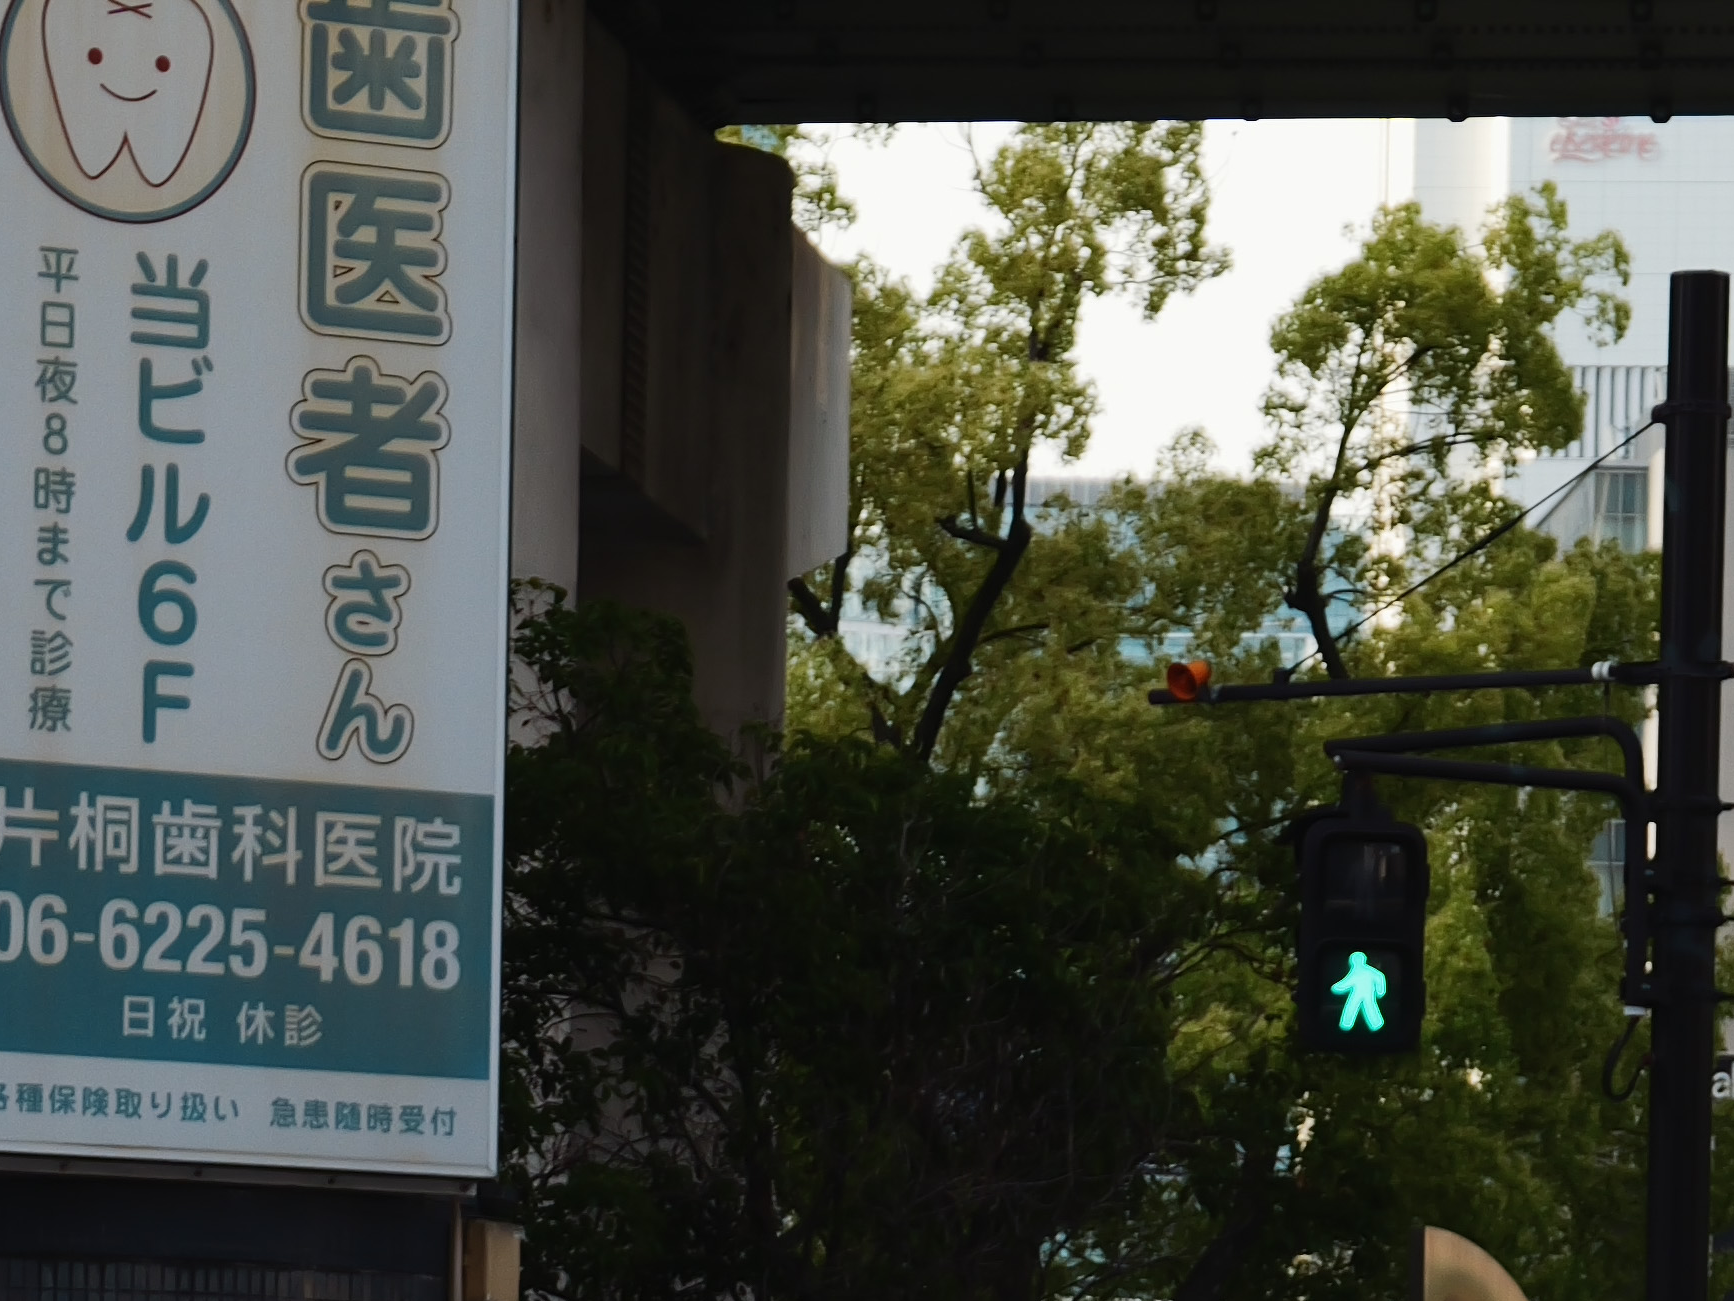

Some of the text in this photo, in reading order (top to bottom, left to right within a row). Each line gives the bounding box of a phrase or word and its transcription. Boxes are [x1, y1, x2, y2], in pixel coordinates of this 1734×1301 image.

[29, 246, 79, 732] 平日夜8時まで診療
[126, 251, 213, 743] 当ビル6F
[285, 0, 460, 763] 歯医者さん
[122, 996, 324, 1048] 日祝 休診
[270, 1097, 458, 1137] 急患随時受付
